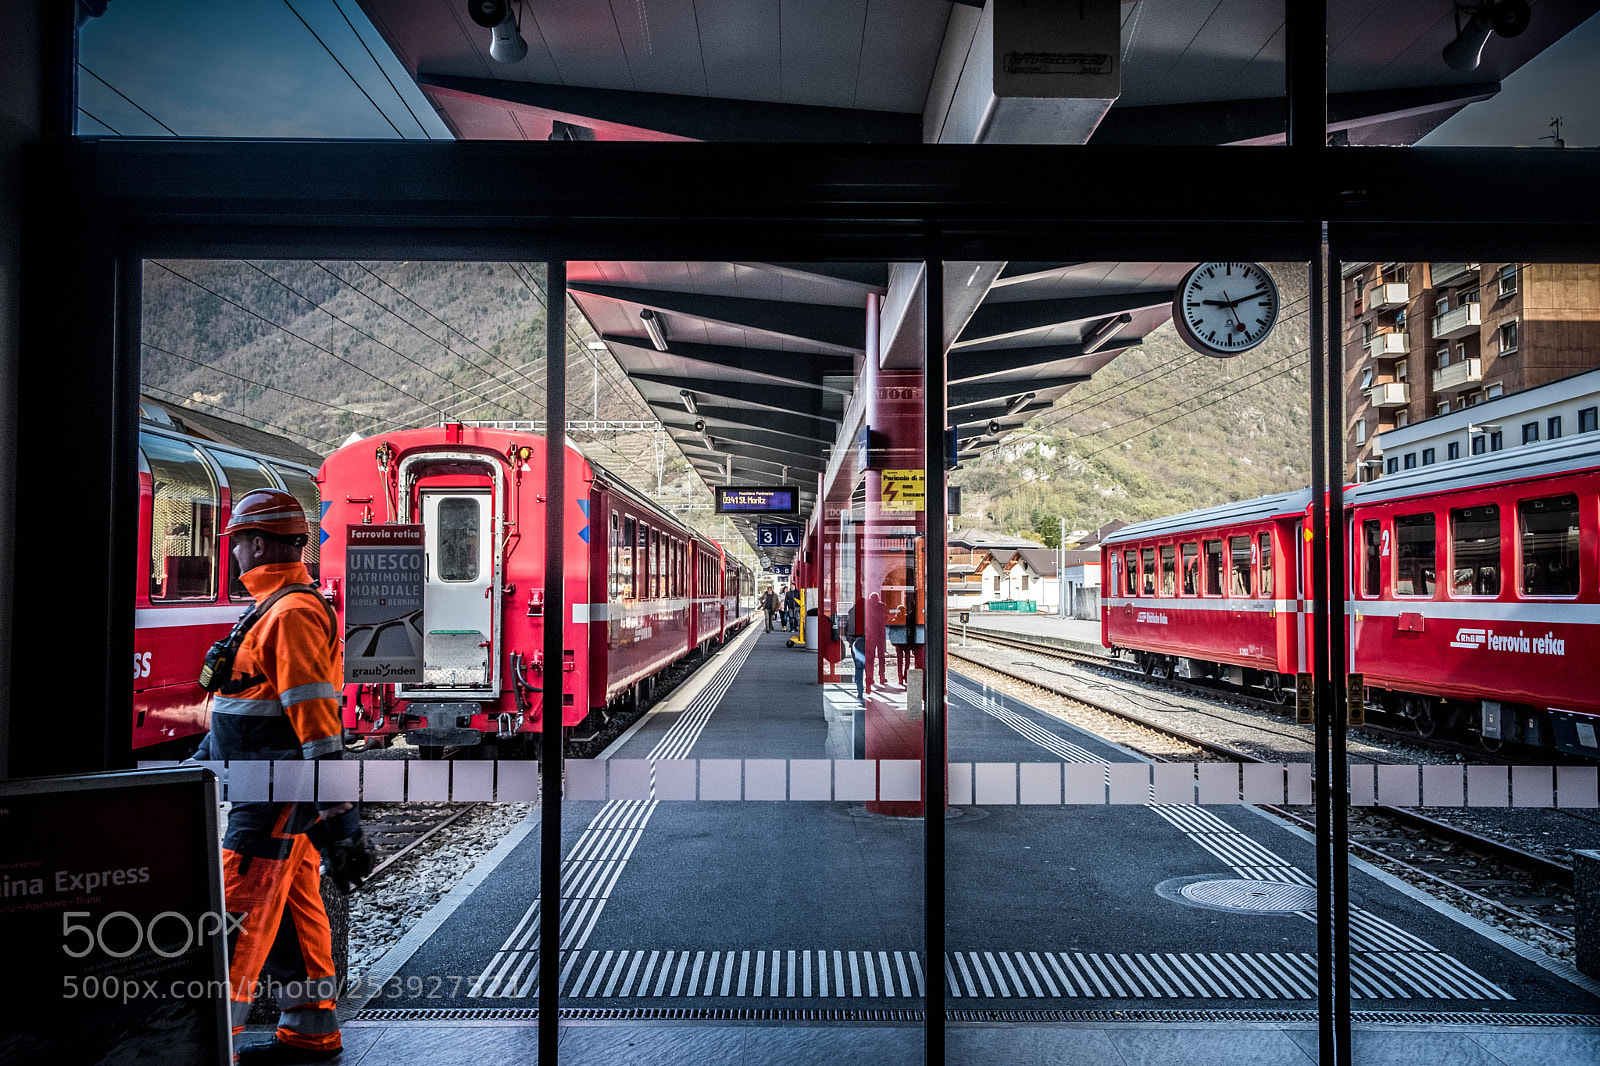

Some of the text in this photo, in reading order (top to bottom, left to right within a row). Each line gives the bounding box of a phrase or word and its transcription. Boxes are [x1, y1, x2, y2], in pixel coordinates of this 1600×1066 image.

[747, 496, 766, 504] Moritz
[351, 529, 420, 539] Ferrovia retica
[763, 532, 772, 543] 3
[785, 532, 795, 543] A
[1381, 529, 1391, 557] 2
[1250, 543, 1257, 565] 2
[350, 554, 421, 570] UNESCO
[350, 572, 420, 582] PATRIMONIO
[350, 585, 420, 596] MONDIALE
[1460, 634, 1476, 643] RhB
[1487, 629, 1565, 655] Ferrovia retica
[0, 866, 151, 898] ina Express
